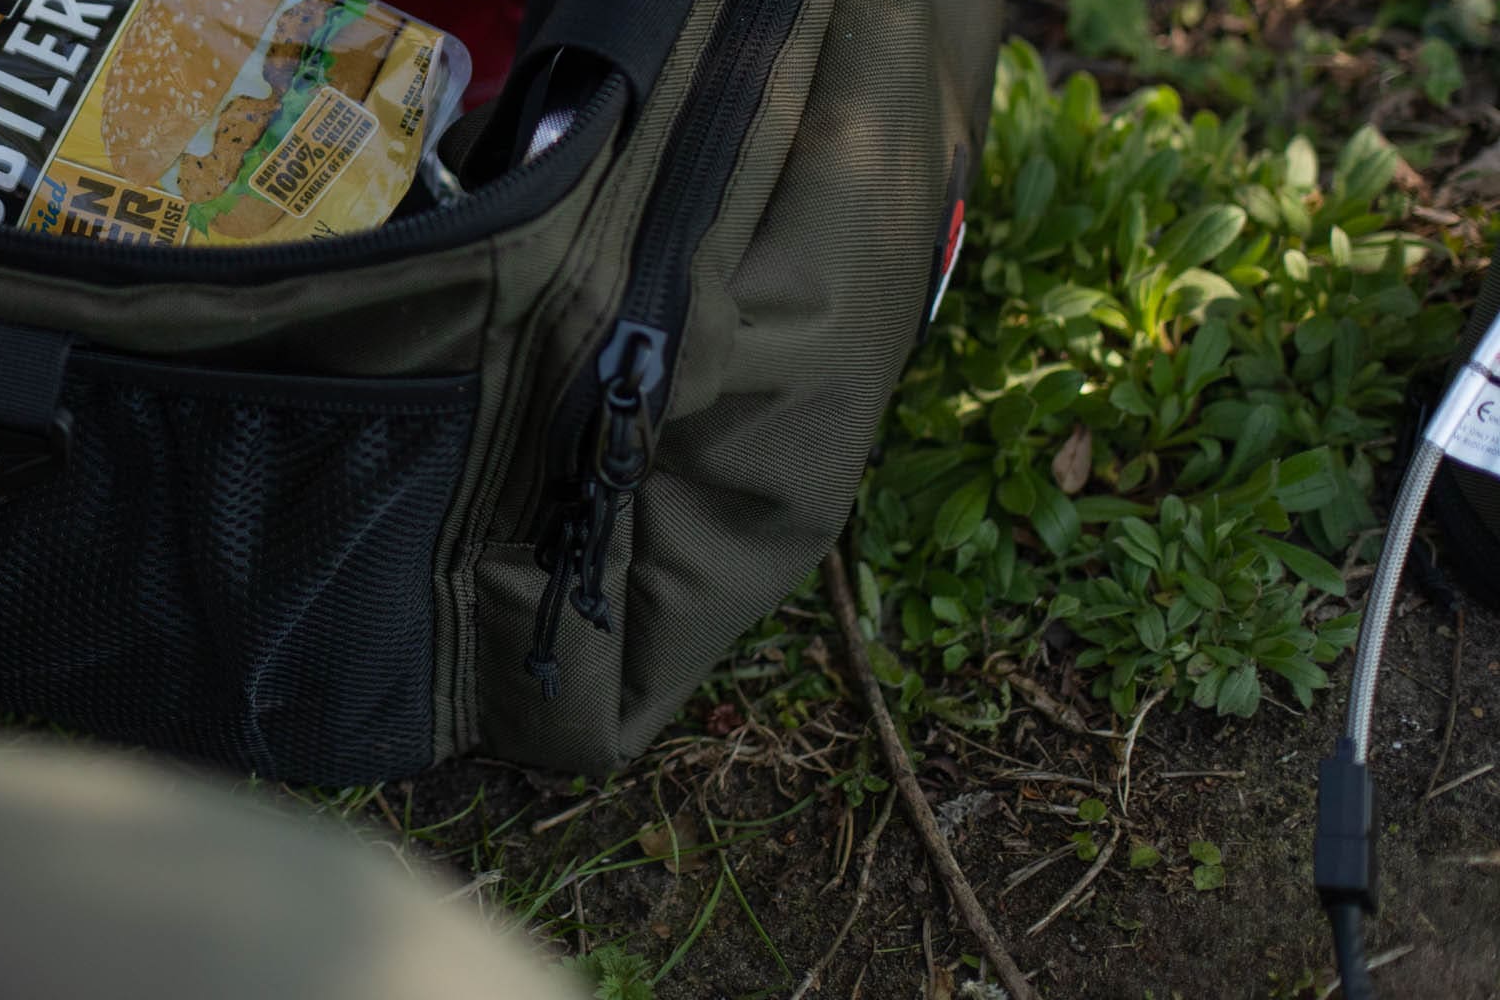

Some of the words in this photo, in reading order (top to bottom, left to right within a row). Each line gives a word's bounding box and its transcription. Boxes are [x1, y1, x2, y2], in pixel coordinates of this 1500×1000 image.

[311, 100, 346, 142] CHICKEN
[322, 108, 357, 149] BREAST
[255, 158, 282, 188] MADE
[279, 134, 303, 160] WITH
[266, 142, 325, 202] 100%
[293, 203, 304, 213] A
[300, 169, 332, 205] SOURCE
[328, 158, 341, 172] OF
[338, 119, 373, 160] PROTEIN
[62, 176, 116, 239] EN
[107, 188, 164, 247] ER
[153, 200, 186, 247] NAISE
